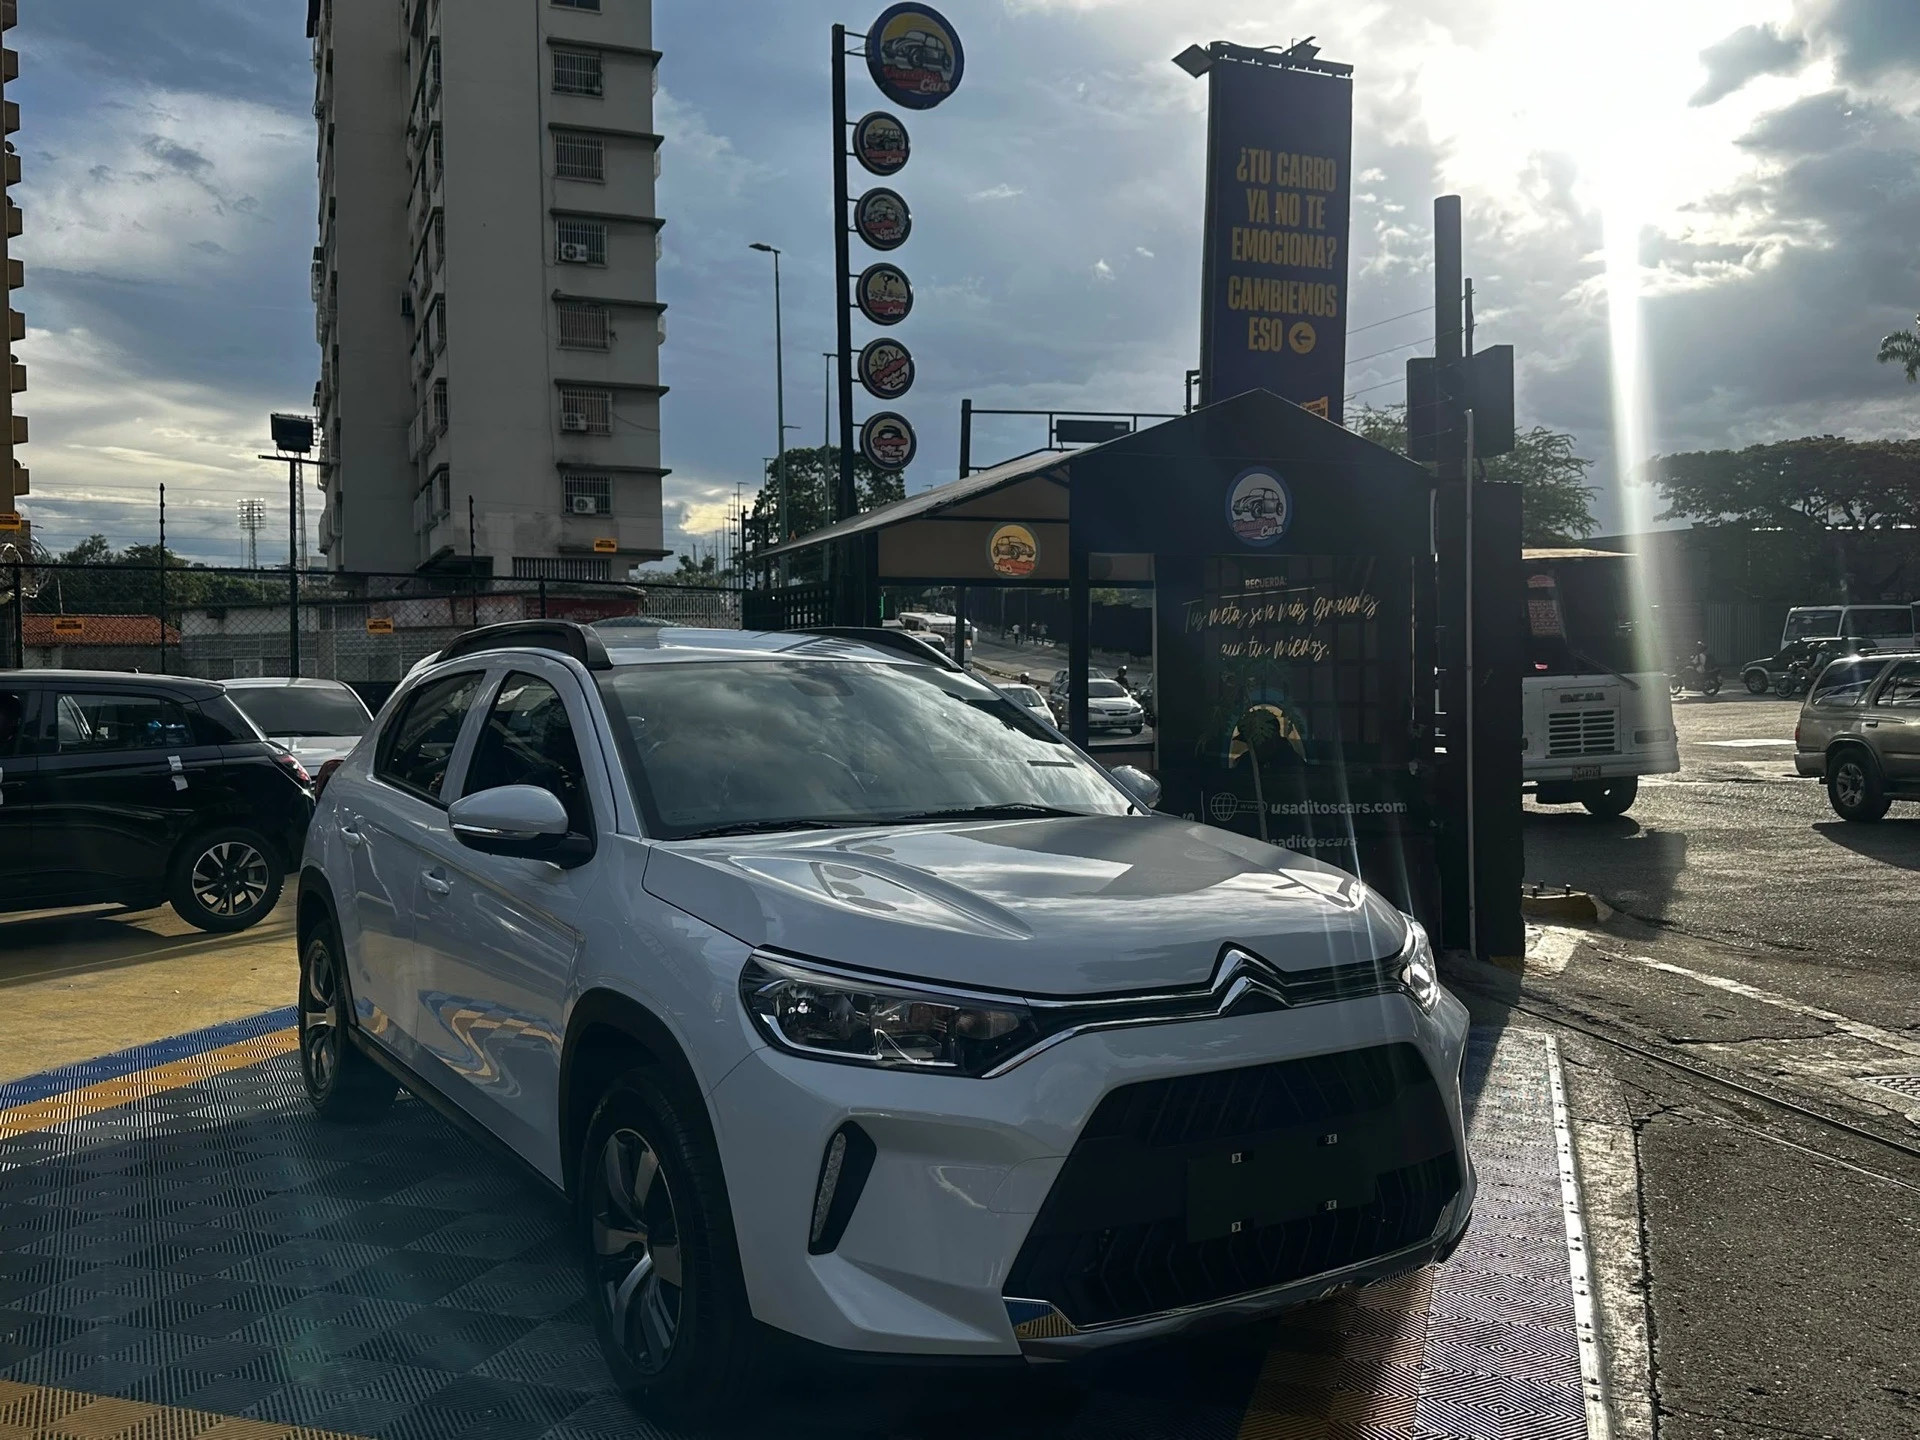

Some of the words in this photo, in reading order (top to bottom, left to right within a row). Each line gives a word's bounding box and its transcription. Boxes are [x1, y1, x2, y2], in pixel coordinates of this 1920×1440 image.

[1236, 147, 1271, 184] ¿TU
[1276, 151, 1337, 192] CARRO
[1246, 188, 1269, 223] YA
[1275, 192, 1300, 228] NO
[1306, 195, 1327, 230] TE
[1231, 227, 1337, 270] EMOCIONA?
[1228, 275, 1337, 318] CAMBIEMOS
[1248, 317, 1283, 352] ESO
[1261, 525, 1283, 537] Cars
[1245, 576, 1288, 589] RECUERDA:
[1248, 604, 1276, 628] son
[1271, 799, 1408, 815] usaditoscars.com
[1267, 835, 1358, 849] saditoscars
